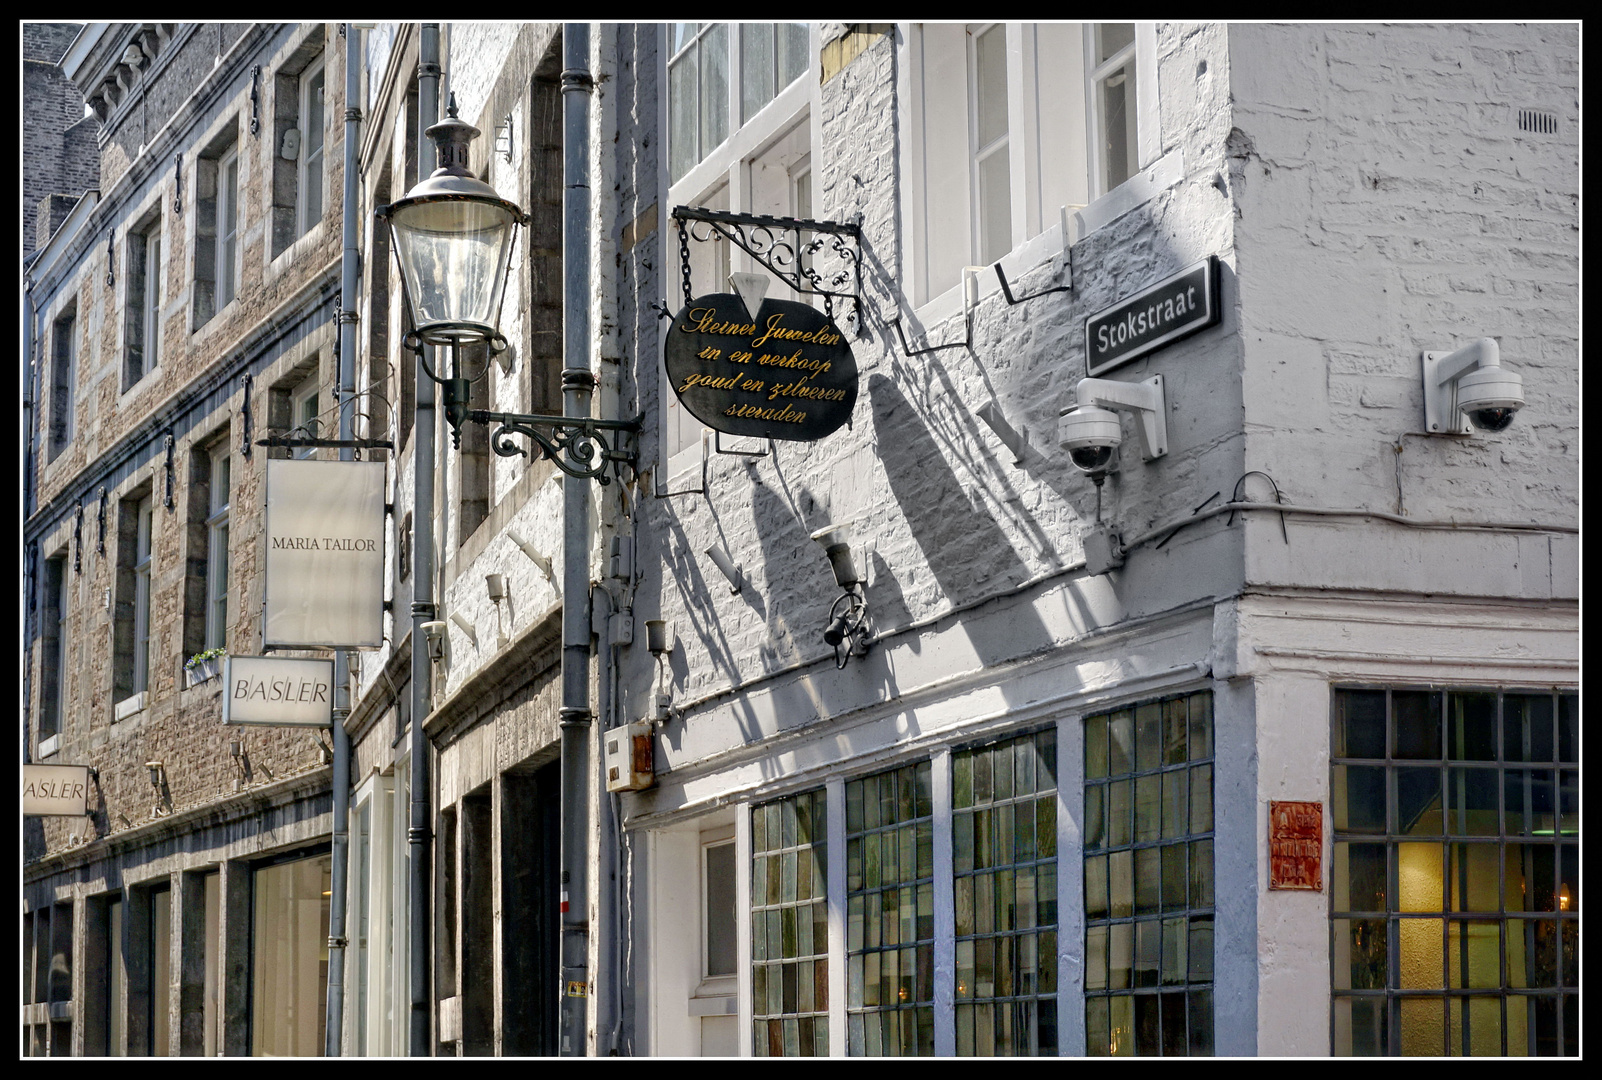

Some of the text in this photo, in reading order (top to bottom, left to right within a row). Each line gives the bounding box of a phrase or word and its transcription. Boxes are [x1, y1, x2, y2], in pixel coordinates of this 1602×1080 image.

[681, 307, 839, 348] Steiner Juwelen
[1097, 285, 1196, 353] Stokstraat
[698, 345, 832, 379] in en verkoop
[679, 372, 847, 401] goud en zilveren
[725, 402, 807, 424] sieraden
[272, 536, 376, 552] MARIA TAILOR
